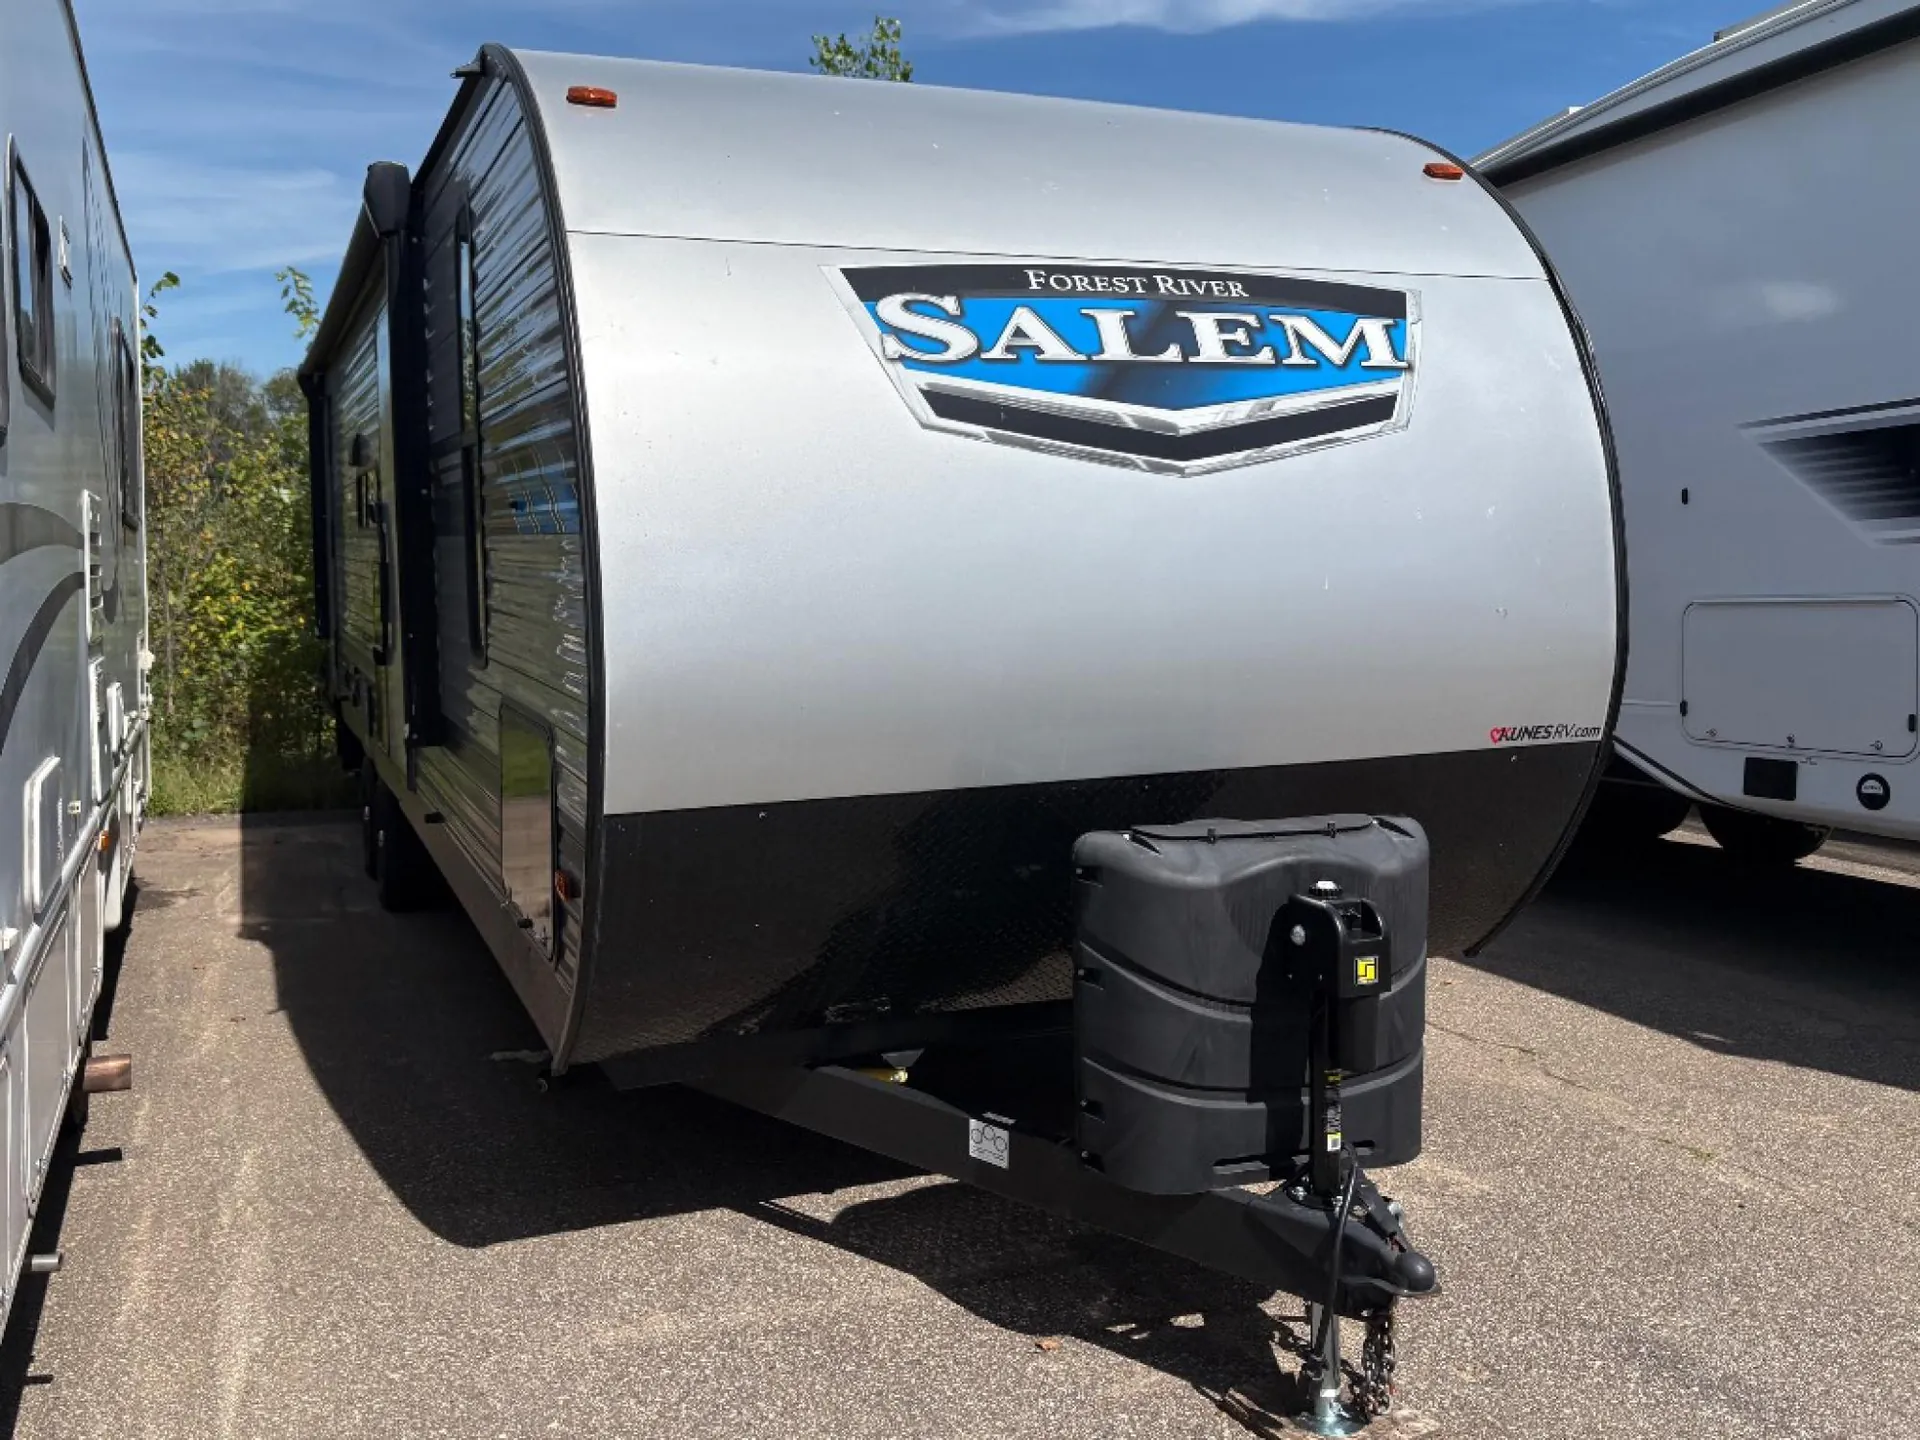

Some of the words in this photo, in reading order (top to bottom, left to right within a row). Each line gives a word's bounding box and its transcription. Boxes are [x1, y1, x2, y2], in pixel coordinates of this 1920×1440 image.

[1024, 269, 1147, 294] FOREST
[1152, 274, 1249, 298] RIVER
[875, 291, 1410, 369] SALEM
